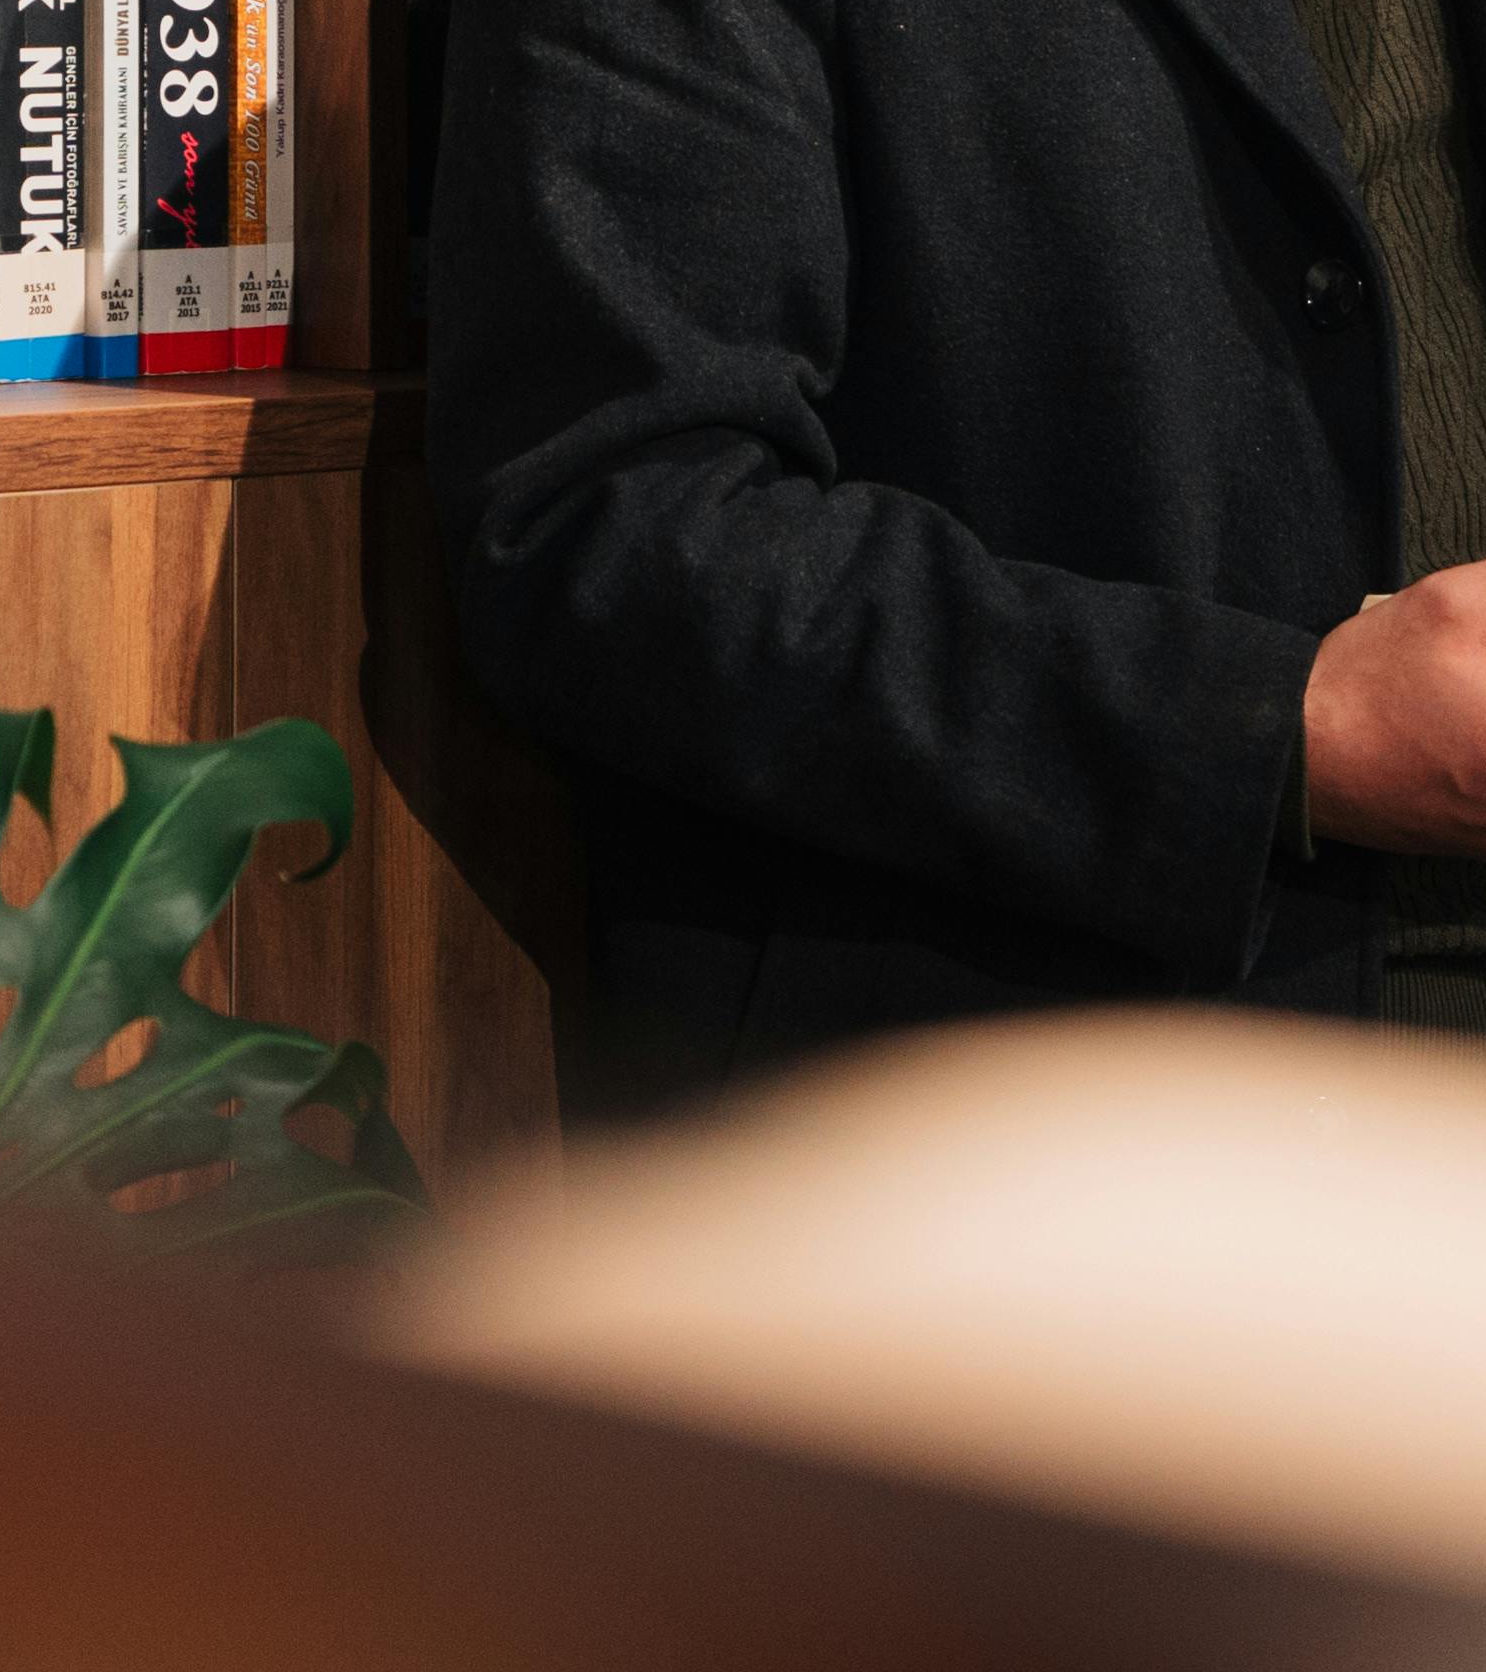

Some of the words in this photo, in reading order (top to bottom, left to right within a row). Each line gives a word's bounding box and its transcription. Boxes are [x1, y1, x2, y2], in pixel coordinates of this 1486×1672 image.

[116, 21, 129, 56] DÜNYA
[66, 47, 77, 108] GENÇLER
[245, 58, 264, 100] Son
[66, 113, 80, 139] İÇİN
[245, 110, 263, 151] 100
[18, 47, 64, 253] NUTUK
[181, 131, 204, 196] son
[243, 160, 264, 220] Günü
[176, 286, 201, 296] 923.1
[180, 297, 198, 306] ATA
[177, 308, 200, 318] 2013
